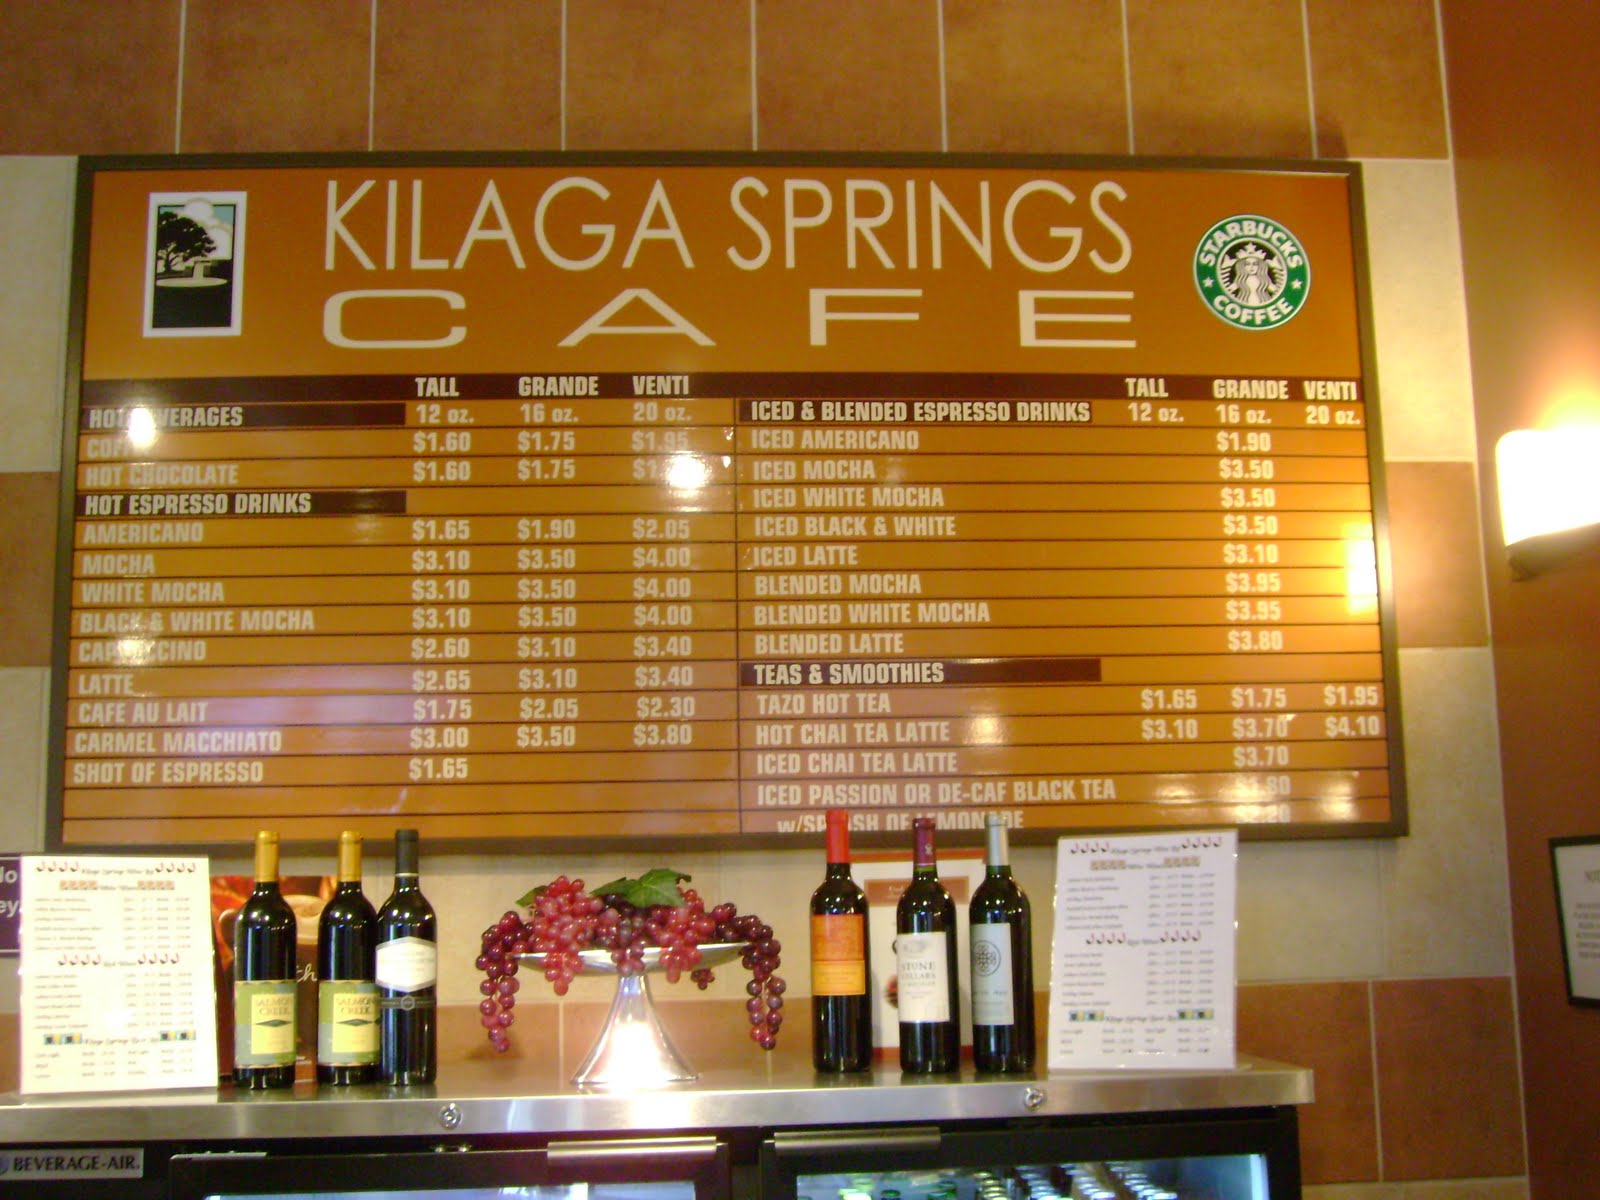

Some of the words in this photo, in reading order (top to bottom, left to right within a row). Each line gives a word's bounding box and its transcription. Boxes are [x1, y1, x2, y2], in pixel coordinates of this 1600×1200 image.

[325, 177, 695, 271] KILAGA
[726, 177, 1132, 273] SPRINGS
[1200, 220, 1303, 268] STARBUCKS
[323, 288, 1136, 349] CAFE
[1214, 295, 1293, 324] COFFEE
[415, 378, 459, 397] TALL
[518, 376, 599, 396] GRANDE
[633, 375, 690, 395] VENTI
[1126, 378, 1168, 398] TALL
[1213, 379, 1288, 399] GRANDE
[1304, 381, 1356, 401] VENTI
[89, 408, 126, 429] HOT
[131, 406, 243, 428] VERAGES
[416, 404, 441, 424] 12
[448, 409, 474, 424] oz.
[520, 404, 545, 423] 16
[552, 409, 579, 423] oz.
[633, 403, 659, 422] 20
[665, 407, 692, 421] oz.
[751, 401, 795, 421] ICED
[800, 401, 816, 421] &
[821, 401, 908, 421] BLENDED
[913, 402, 1010, 422] ESPRESSO
[1016, 403, 1091, 422] DRINKS
[1128, 403, 1151, 422] 12
[1159, 407, 1184, 422] oz.
[1216, 404, 1239, 423] 16
[1246, 408, 1271, 423] oz.
[1306, 405, 1329, 424] 20
[1335, 410, 1361, 425] oz.
[413, 431, 471, 453] $1.60
[518, 430, 575, 452] $1.75
[632, 430, 689, 452] $1.95
[751, 429, 795, 450] ICED
[801, 430, 920, 450] AMERICANO
[1217, 431, 1271, 452] $1.90
[86, 466, 122, 487] HOT
[130, 464, 239, 486] CHOCOLATE
[413, 459, 471, 482] $1.60
[518, 458, 575, 481] $1.75
[753, 460, 797, 481] ICED
[803, 460, 876, 480] MOCHA
[1219, 458, 1274, 479] $3.50
[85, 495, 123, 516] HOT
[129, 494, 228, 515] ESPRESSO
[234, 493, 311, 513] DRINKS
[753, 488, 797, 508] ICED
[803, 488, 865, 508] WHITE
[872, 487, 945, 507] MOCHA
[1221, 486, 1276, 508] $3.50
[83, 522, 204, 544] AMERICANO
[412, 518, 470, 541] $1.65
[518, 518, 576, 541] $1.90
[632, 518, 690, 540] $2.05
[754, 516, 799, 537] ICED
[805, 516, 868, 537] BLACK
[873, 516, 887, 536] &
[894, 516, 956, 536] WHITE
[1223, 514, 1278, 536] $3.50
[82, 554, 156, 575] MOCHA
[412, 549, 470, 571] $3.10
[518, 547, 576, 570] $3.50
[632, 546, 691, 569] $4.00
[753, 546, 797, 567] ICED
[803, 545, 859, 566] LATTE
[1224, 543, 1278, 564] $3.10
[82, 583, 144, 604] WHITE
[151, 582, 224, 603] MOCHA
[412, 578, 470, 600] $3.10
[518, 577, 576, 600] $3.50
[632, 576, 691, 598] $4.00
[754, 575, 842, 596] BLENDED
[850, 574, 922, 595] MOCHA
[1226, 572, 1280, 593] $3.95
[80, 611, 143, 633] BLACK
[150, 611, 163, 632] &
[170, 610, 233, 632] WHITE
[240, 609, 315, 631] MOCHA
[412, 606, 471, 630] $3.10
[518, 605, 577, 628] $3.50
[633, 604, 693, 627] $4.00
[754, 605, 841, 626] BLENDED
[849, 603, 912, 624] WHITE
[918, 602, 991, 623] MOCHA
[1226, 600, 1281, 621] $3.95
[79, 640, 207, 662] CAPCINO
[411, 637, 470, 660] $2.60
[518, 636, 576, 659] $3.10
[633, 635, 692, 657] $3.40
[754, 634, 842, 655] BLENDED
[849, 632, 905, 654] LATTE
[1228, 630, 1283, 651] $3.80
[79, 674, 134, 695] LATTE
[412, 669, 471, 692] $2.65
[518, 667, 577, 690] $3.10
[635, 665, 694, 688] $3.40
[754, 664, 802, 685] TEAS
[808, 664, 823, 684] &
[829, 662, 945, 684] SMOOTHIES
[757, 694, 805, 715] TAZO
[812, 694, 850, 714] HOT
[855, 693, 891, 713] TEA
[1141, 688, 1197, 710] $1.65
[1232, 686, 1286, 708] $1.75
[1324, 685, 1378, 706] $1.95
[79, 703, 125, 723] CAFE
[133, 702, 159, 723] AU
[164, 702, 208, 722] LAIT
[413, 698, 472, 721] $1.75
[520, 697, 579, 720] $2.05
[636, 696, 696, 719] $2.30
[517, 725, 576, 748] $3.50
[633, 724, 693, 747] $3.80
[755, 724, 795, 745] HOT
[800, 723, 847, 744] CHAI
[854, 722, 889, 743] TEA
[895, 721, 950, 742] LATTE
[1142, 718, 1198, 740] $3.10
[1233, 717, 1288, 739] $3.70
[1326, 715, 1380, 737] $4.10
[75, 731, 156, 752] CARMEL
[163, 731, 282, 752] MACCHIATO
[409, 727, 469, 750] $3.00
[757, 754, 800, 774] ICED
[808, 753, 855, 774] CHAI
[861, 752, 896, 773] TEA
[902, 751, 958, 772] LATTE
[1234, 746, 1289, 768] $3.70
[74, 762, 125, 783] SHOT
[131, 762, 155, 782] OF
[162, 761, 264, 782] ESPRESSO
[409, 757, 468, 781] $1.65
[758, 784, 801, 805] ICED
[809, 783, 898, 805] PASSION
[904, 782, 930, 803] OR
[937, 780, 1007, 802] DE-CAF
[1013, 780, 1075, 801] BLACK
[1080, 779, 1116, 800] TEA
[777, 813, 879, 833] w/SPSH
[886, 813, 909, 831] OF
[916, 811, 1023, 830] MONDE
